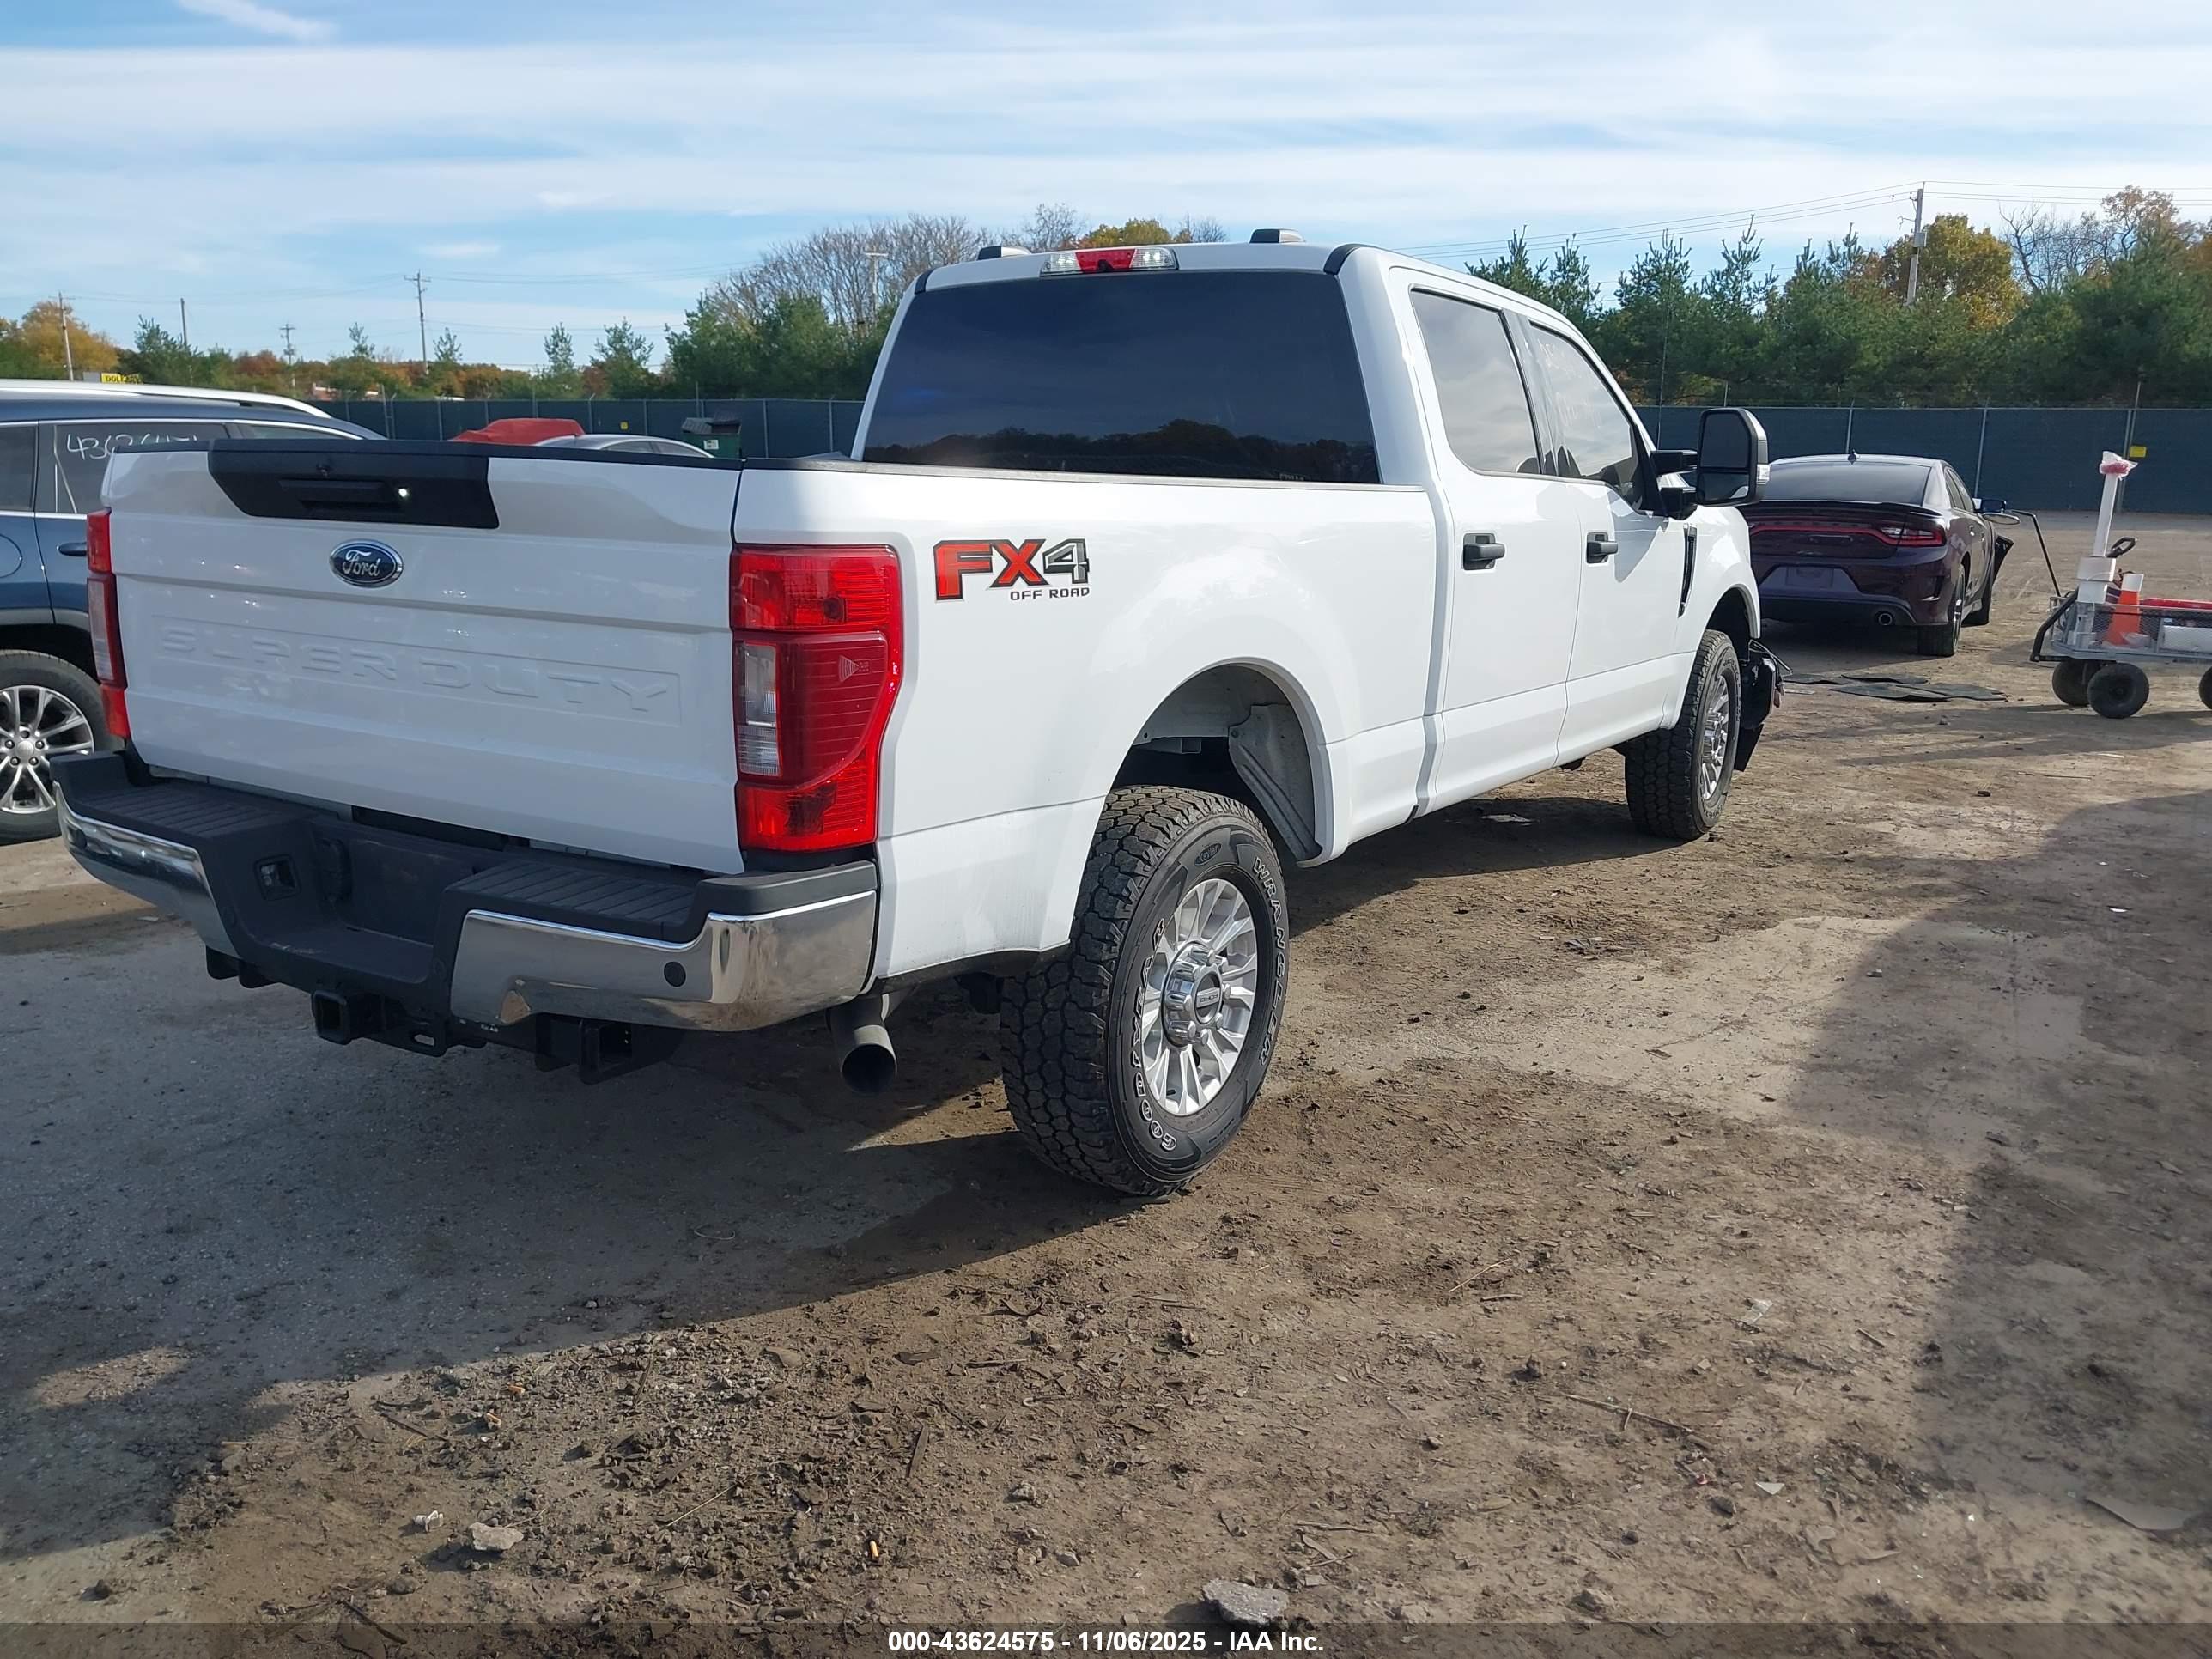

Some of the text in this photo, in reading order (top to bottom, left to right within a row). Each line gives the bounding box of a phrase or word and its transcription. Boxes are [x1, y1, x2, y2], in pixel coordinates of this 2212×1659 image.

[343, 550, 380, 576] Ford
[933, 538, 1090, 600] FX4
[1010, 586, 1090, 601] OFF ROAD
[161, 624, 669, 714] SUPER DUTY
[1253, 856, 1285, 1066] WRANGLER
[1132, 917, 1177, 1152] GOODYEAR
